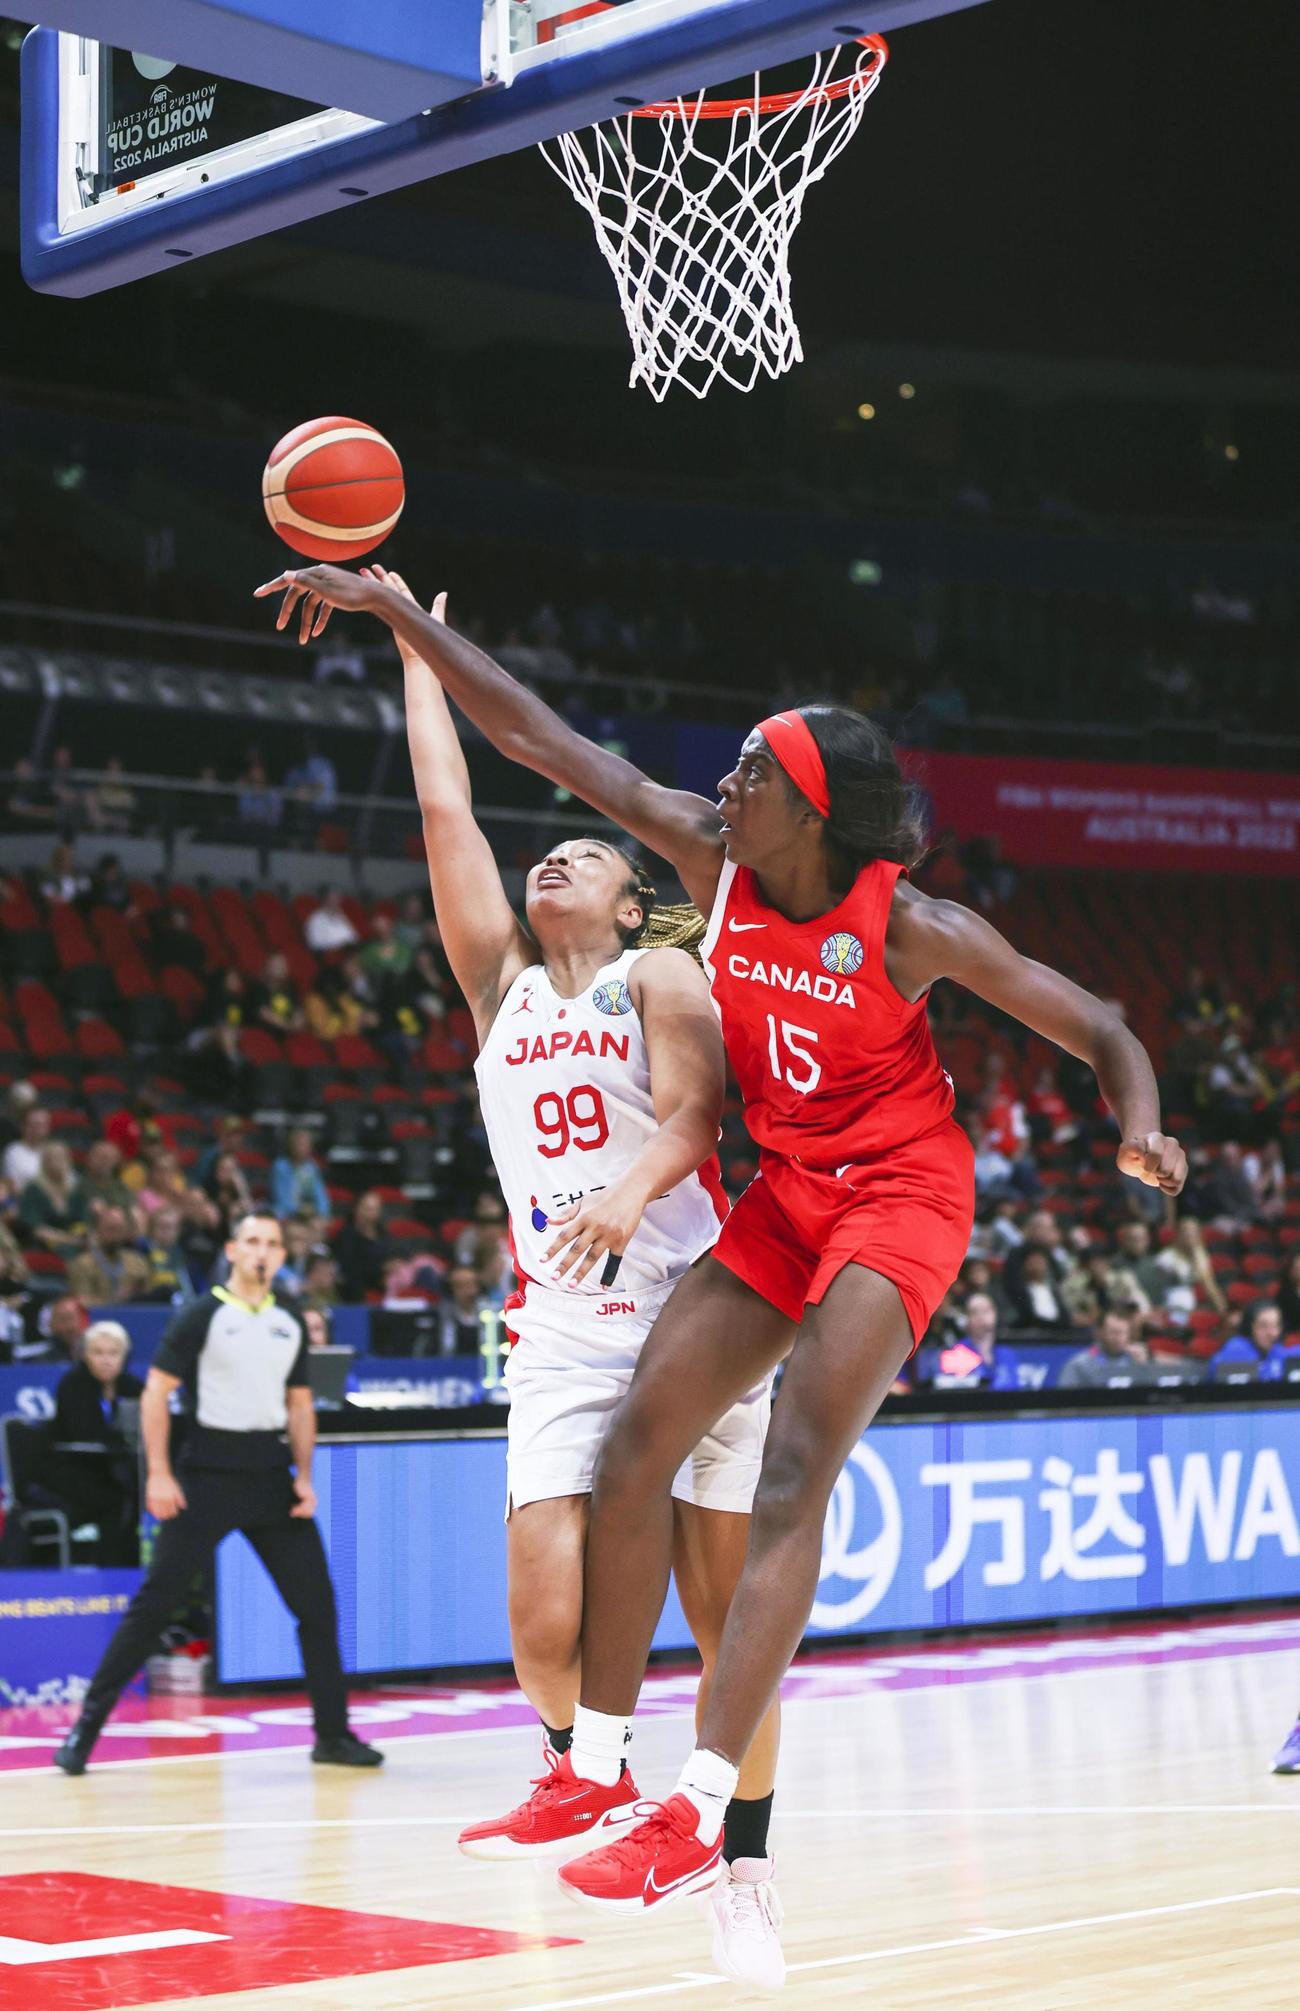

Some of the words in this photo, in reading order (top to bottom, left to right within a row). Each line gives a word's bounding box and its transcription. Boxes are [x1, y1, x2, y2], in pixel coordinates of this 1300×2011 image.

[728, 954, 856, 1009] CANADA
[505, 1030, 629, 1065] JAPAN
[766, 1013, 822, 1096] 15
[533, 1084, 609, 1159] 99
[596, 1300, 636, 1315] JPN
